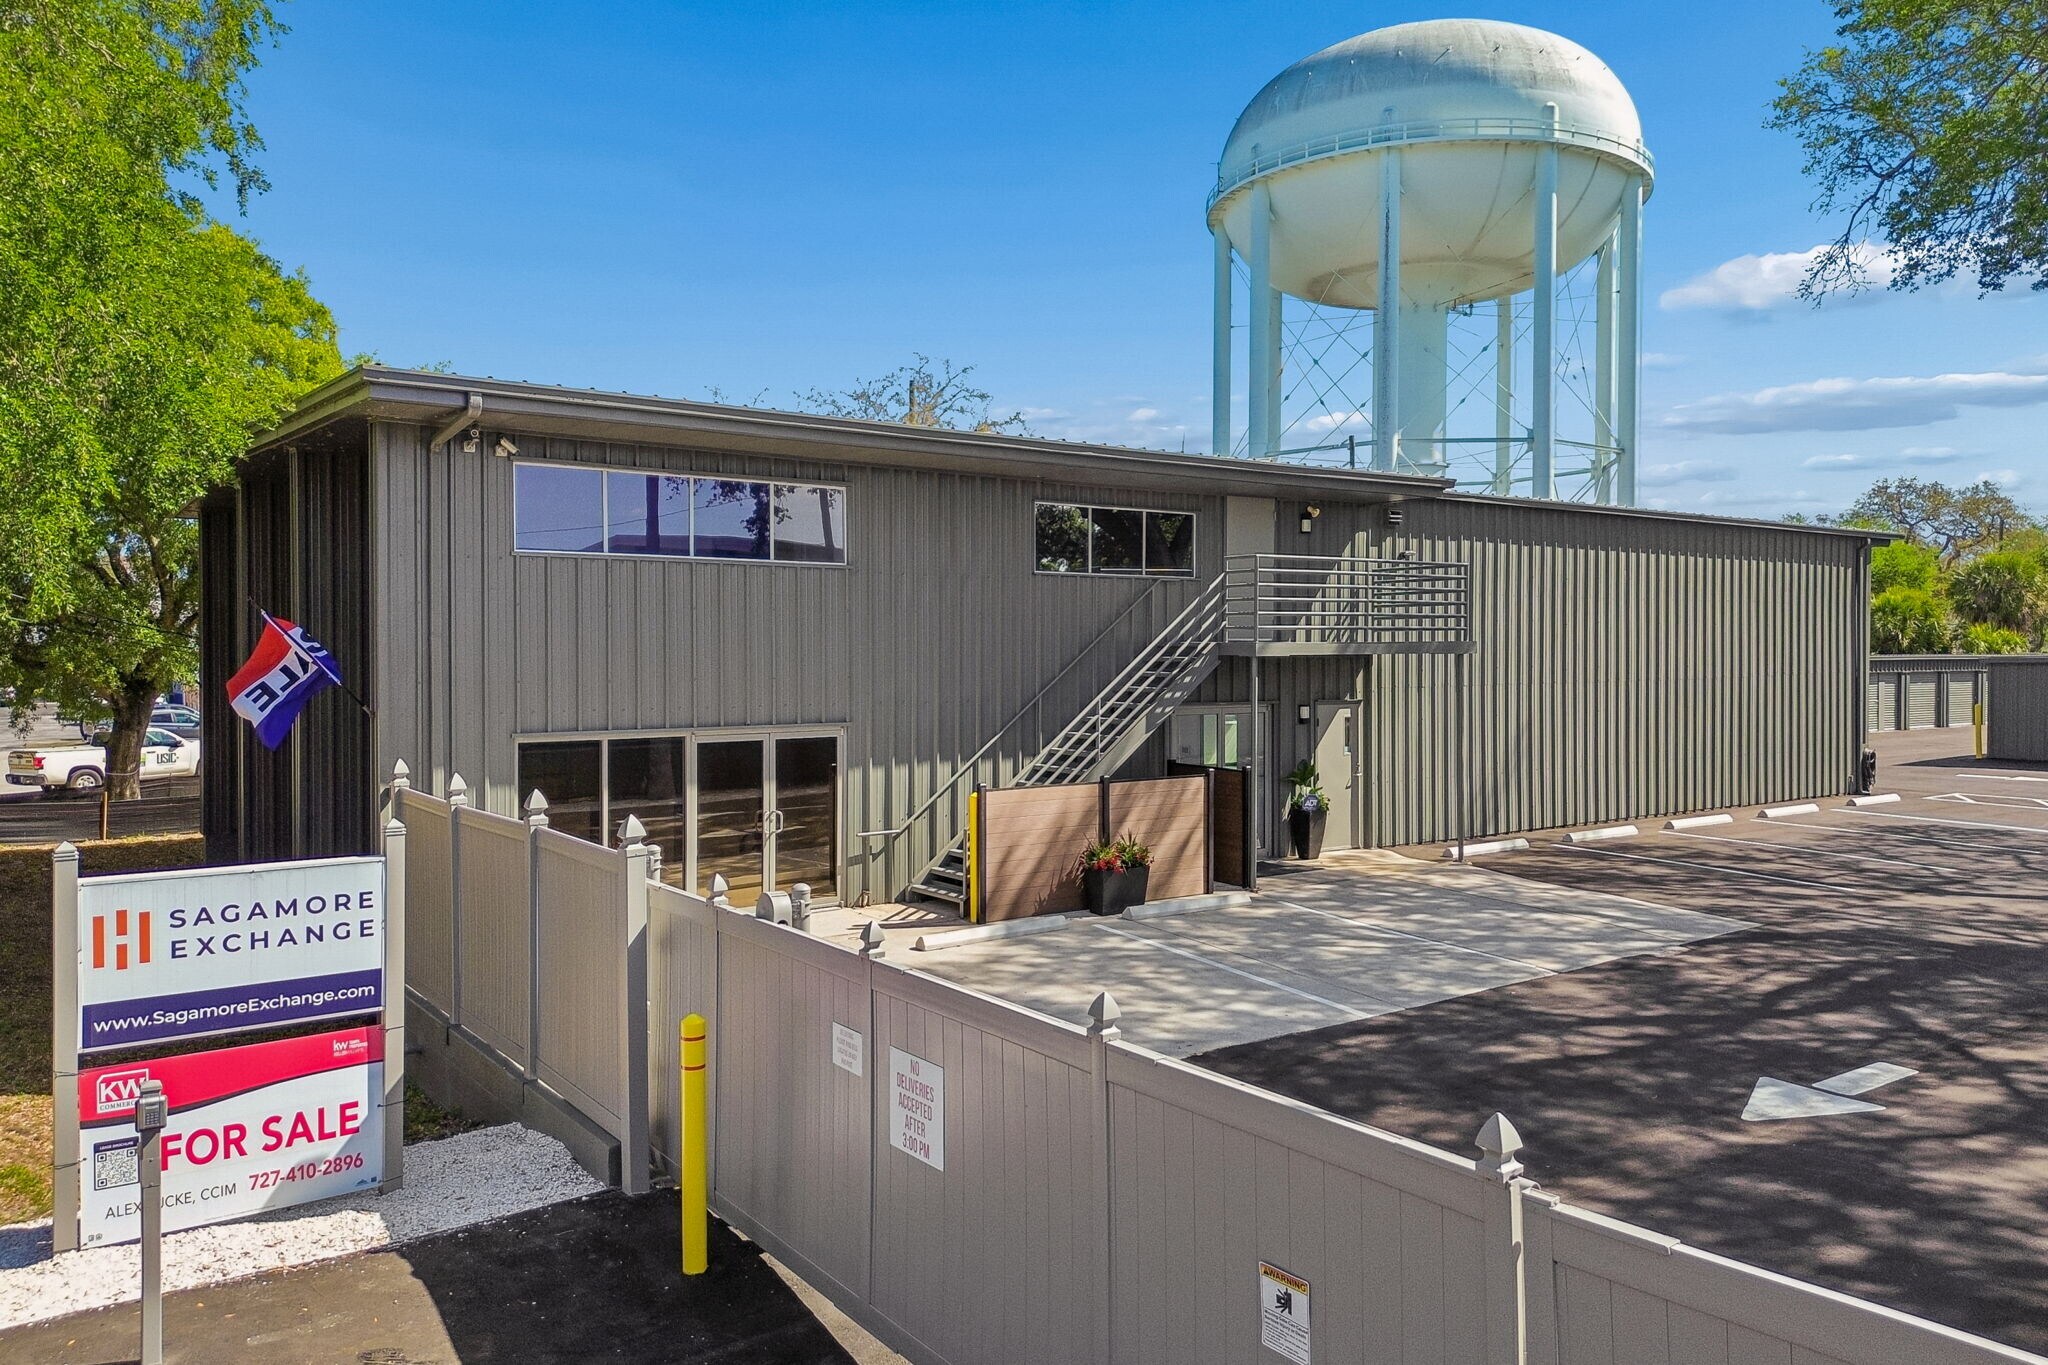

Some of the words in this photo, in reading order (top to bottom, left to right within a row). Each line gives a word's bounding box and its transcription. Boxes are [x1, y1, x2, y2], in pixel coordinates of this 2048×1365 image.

[156, 752, 177, 764] USIC
[169, 890, 374, 928] SAGAMORE
[170, 919, 375, 959] EXCHANGE
[93, 985, 375, 1033] www.SagamoreExchange.com
[910, 1059, 920, 1077] NO
[100, 1077, 146, 1102] KW
[896, 1072, 934, 1103] DELIVERIES
[100, 1100, 136, 1112] COMMERC
[898, 1092, 932, 1121] ACCEPTED
[161, 1123, 248, 1171] FOR
[262, 1101, 360, 1152] SALE
[904, 1114, 926, 1138] AFTER
[902, 1132, 918, 1154] 3:00
[919, 1142, 930, 1160] PM
[249, 1153, 364, 1190] 727-410-2896
[105, 1202, 142, 1220] ALEX
[161, 1191, 196, 1208] CKE,
[200, 1183, 237, 1201] CCIM
[1269, 1269, 1306, 1292] WARNING
